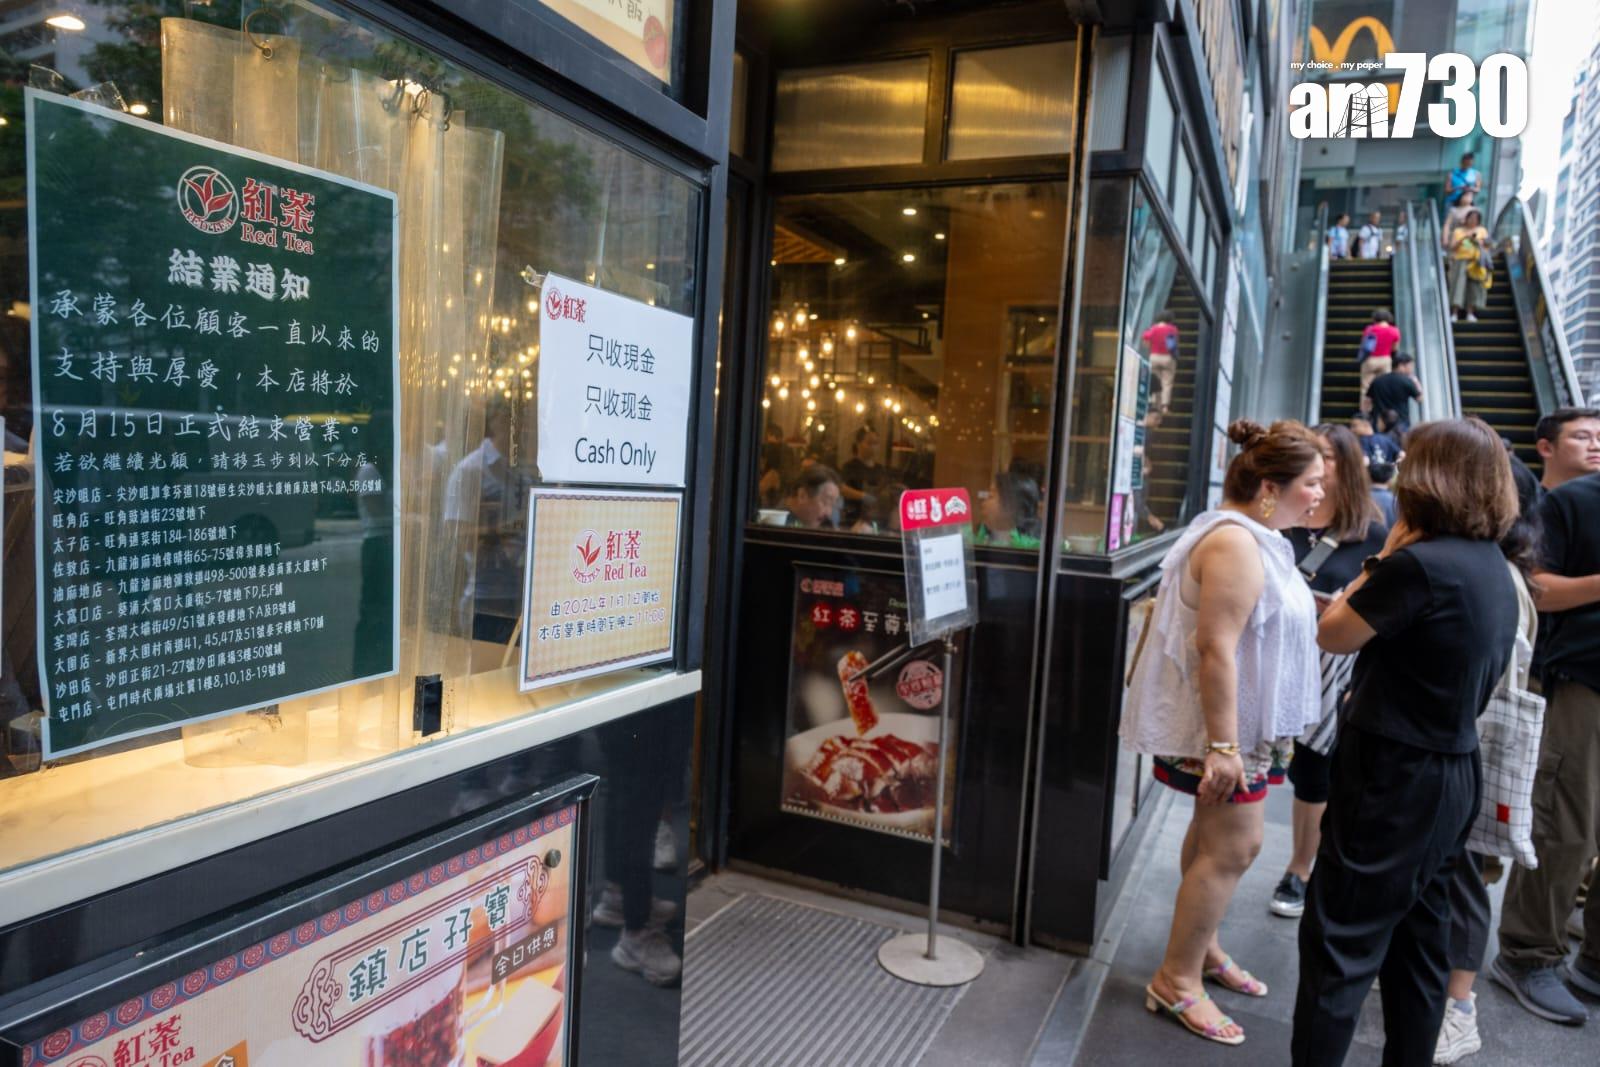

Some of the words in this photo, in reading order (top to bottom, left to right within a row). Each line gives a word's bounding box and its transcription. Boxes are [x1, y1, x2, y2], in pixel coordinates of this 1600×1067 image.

[241, 177, 316, 234] 紅茶
[241, 222, 278, 248] Red
[283, 231, 314, 255] Tea
[168, 247, 311, 302] 結業通知
[50, 289, 381, 353] 承蒙各位顧客一直以來的
[562, 294, 586, 323] 紅茶
[586, 334, 655, 374] 只收現金
[584, 385, 653, 421] 只收现金
[575, 437, 615, 464] Cash
[620, 441, 656, 474] Only
[53, 487, 101, 505] 尖沙咀店
[52, 512, 89, 529] 旺角店
[53, 537, 90, 554] 太子店
[604, 530, 641, 560] 紅茶
[53, 560, 90, 578] 佐敦店
[604, 564, 625, 581] Red
[629, 561, 647, 578] Tea
[53, 582, 103, 603] 油麻地店
[53, 605, 102, 627] 大窩口店
[53, 630, 90, 651] 荃灣店
[55, 653, 90, 675] 大圍店
[56, 677, 91, 699] 沙田店
[59, 700, 93, 722] 屯門店
[349, 886, 510, 1002] 鎮店孖寶
[495, 927, 555, 976] 全日供應
[113, 1014, 182, 1067] 紅茶
